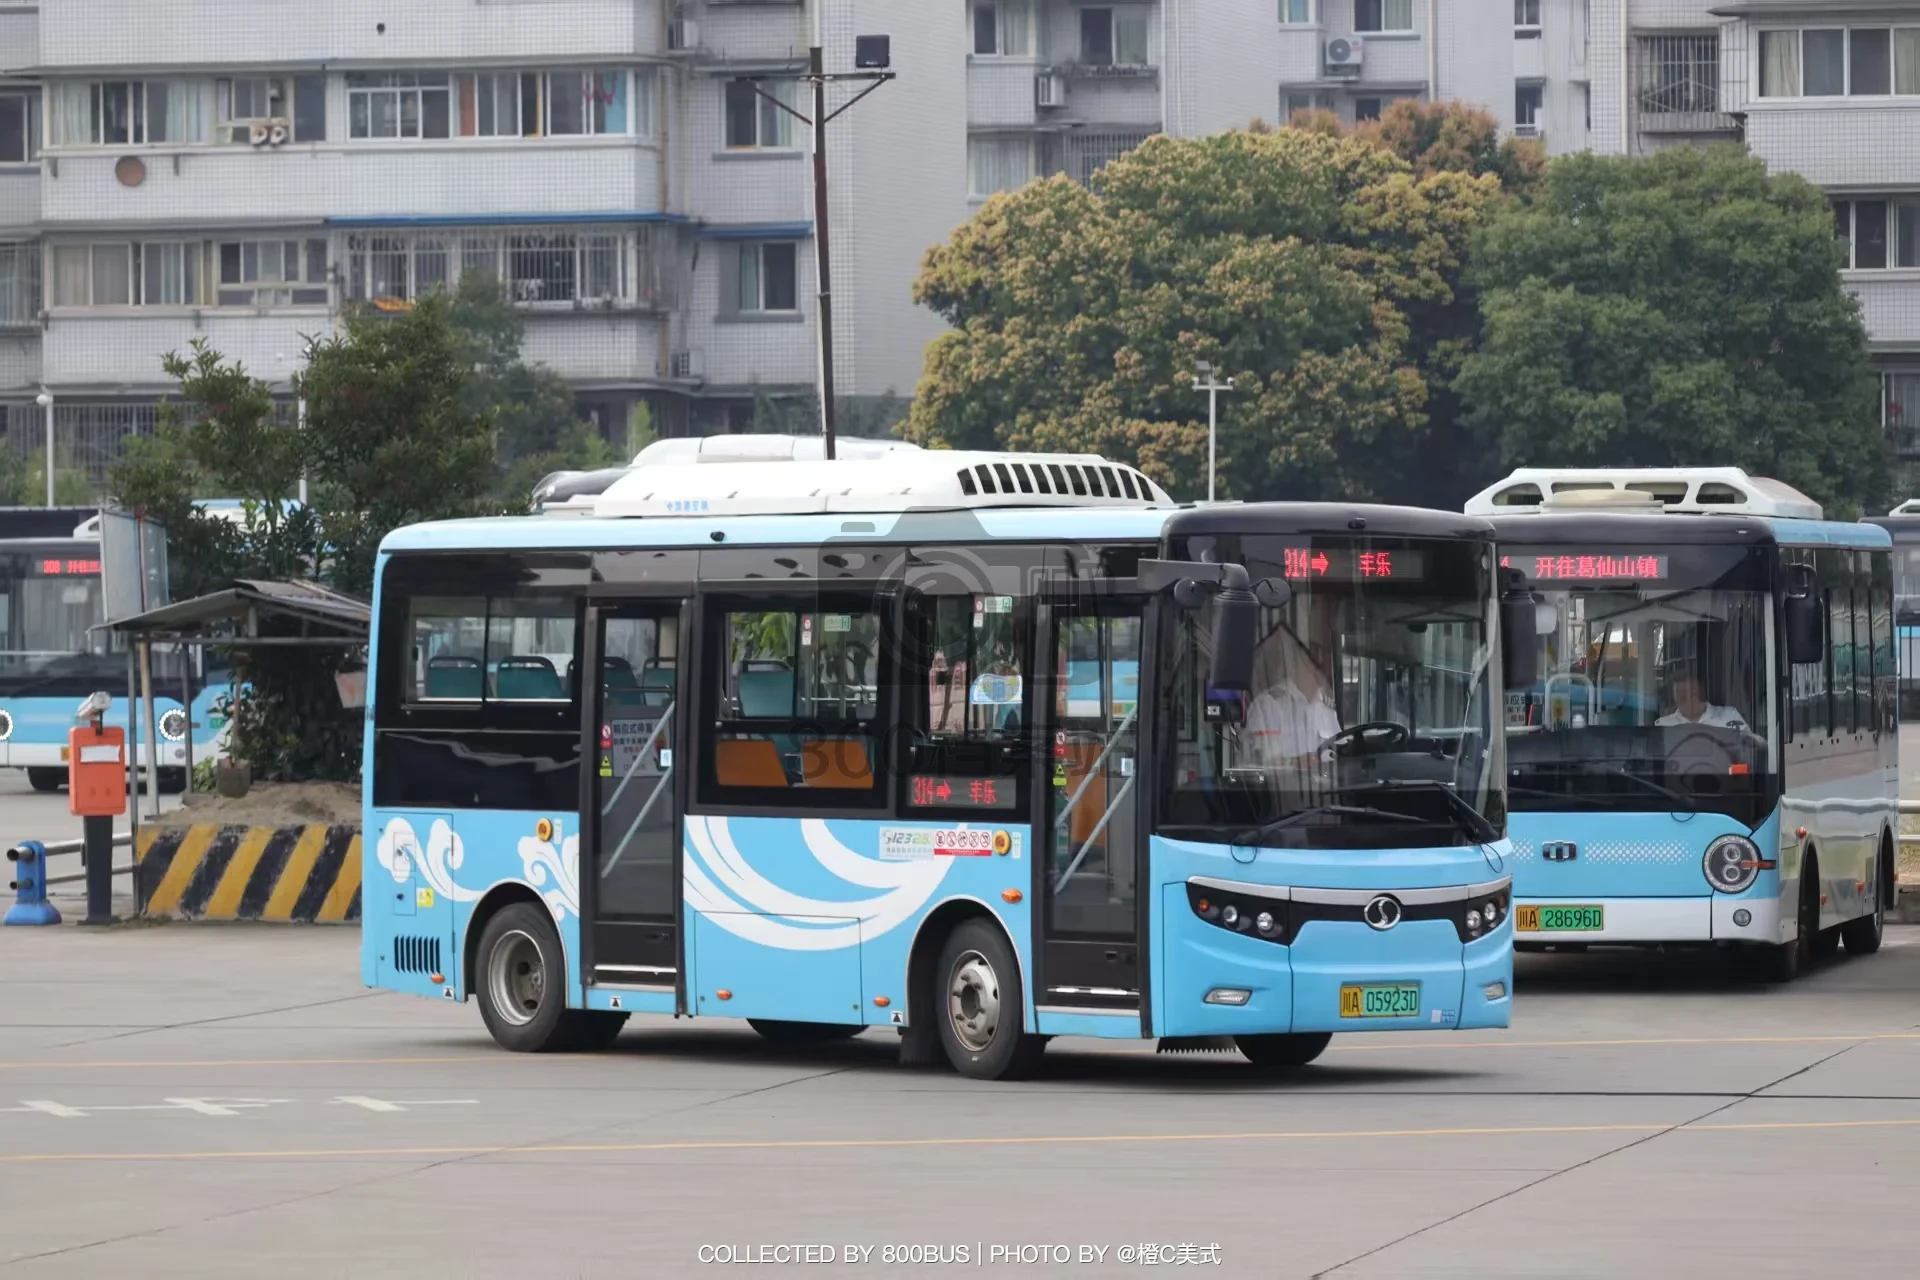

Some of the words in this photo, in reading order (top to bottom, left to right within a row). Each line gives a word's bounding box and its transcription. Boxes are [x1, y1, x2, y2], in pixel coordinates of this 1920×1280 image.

[1360, 553, 1391, 576] 丰乐
[1536, 556, 1658, 578] 开往葛仙山镇
[969, 780, 996, 804] 丰乐
[1545, 909, 1601, 928] 28696D
[1366, 990, 1418, 1012] 05923D
